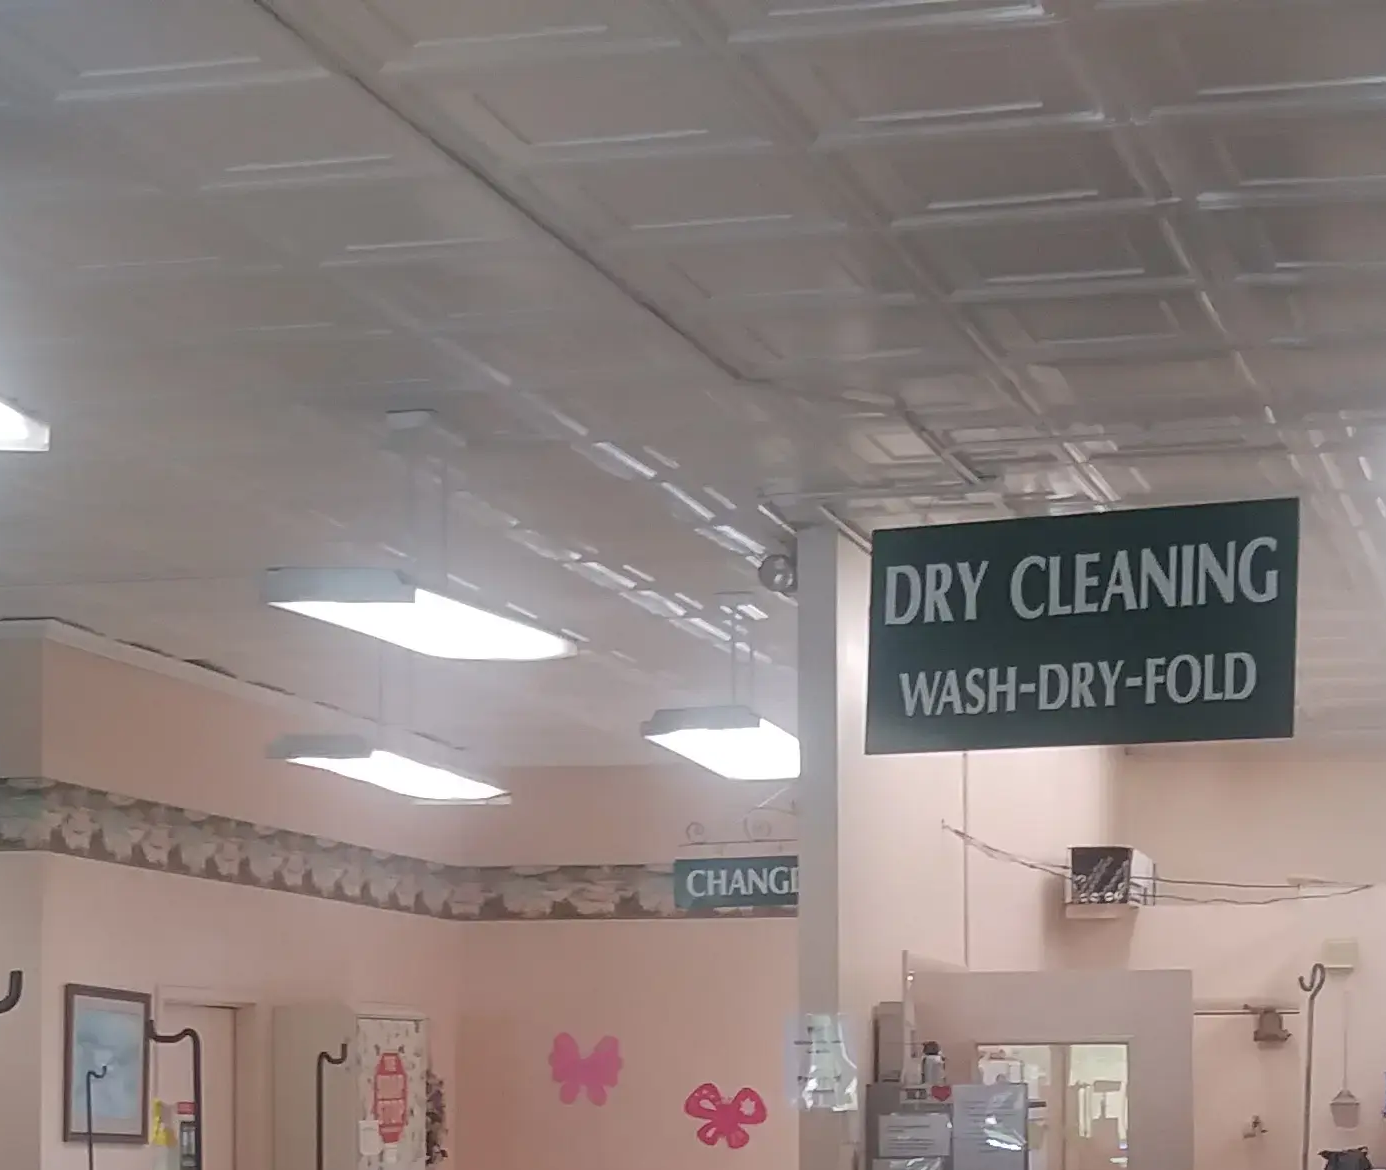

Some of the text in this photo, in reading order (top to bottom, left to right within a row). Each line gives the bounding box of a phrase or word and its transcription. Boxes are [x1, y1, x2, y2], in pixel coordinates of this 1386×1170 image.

[883, 535, 1280, 627] DRY CLEANING
[899, 651, 1258, 718] WASH-DRY-FOLD
